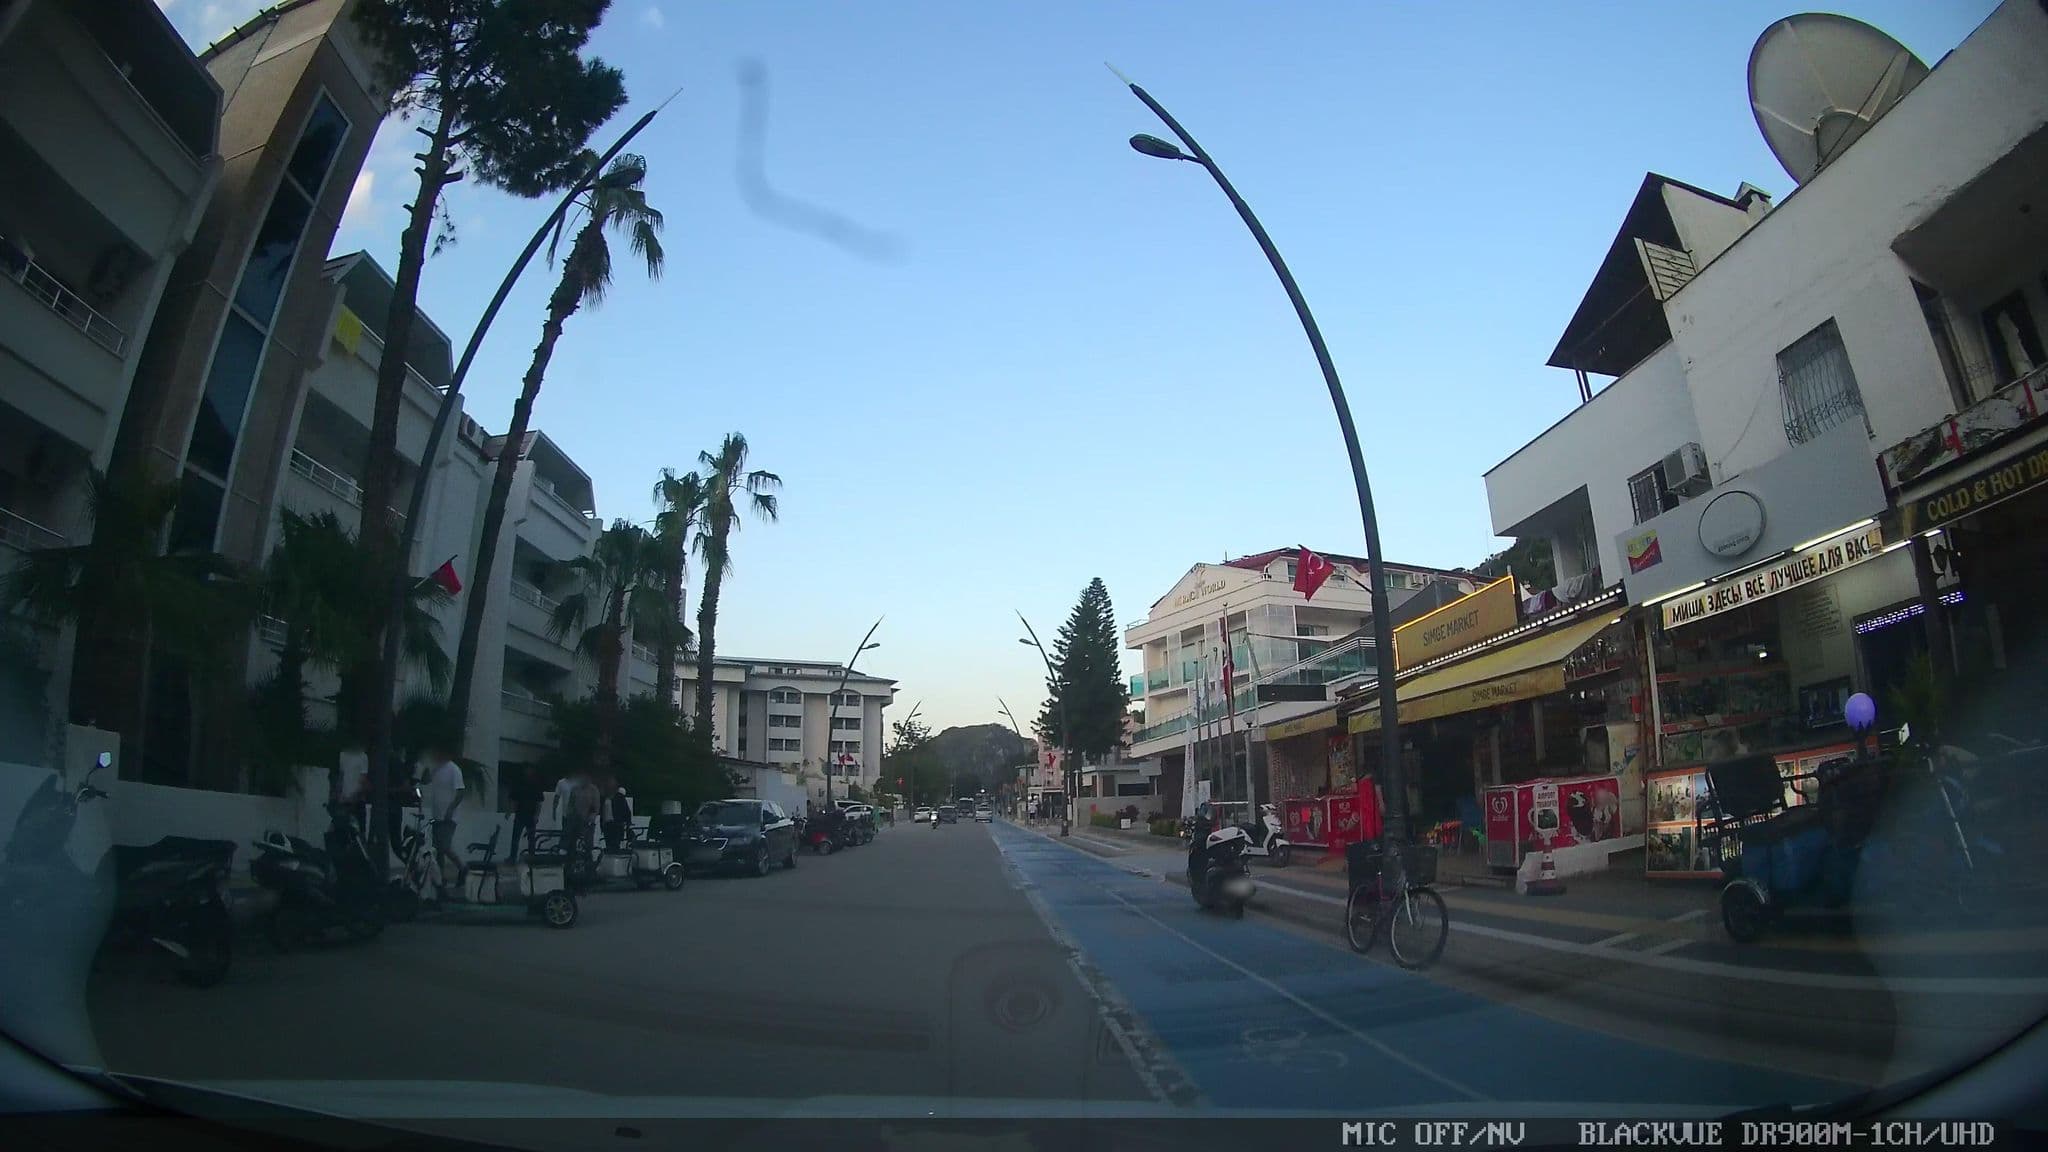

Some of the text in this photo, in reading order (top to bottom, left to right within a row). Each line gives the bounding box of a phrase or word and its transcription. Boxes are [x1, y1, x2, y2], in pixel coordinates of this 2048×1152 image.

[1927, 487, 1970, 521] COLD
[1974, 480, 1989, 502] &
[1989, 462, 2024, 496] HOT
[1672, 533, 1870, 623] МИША ЗДЕСЬ! ВСЁ ЛУЧШЕЕ ДЛЯ ВАС!
[1423, 610, 1479, 646] SIMGE MARKET
[1491, 682, 1517, 698] MARKET
